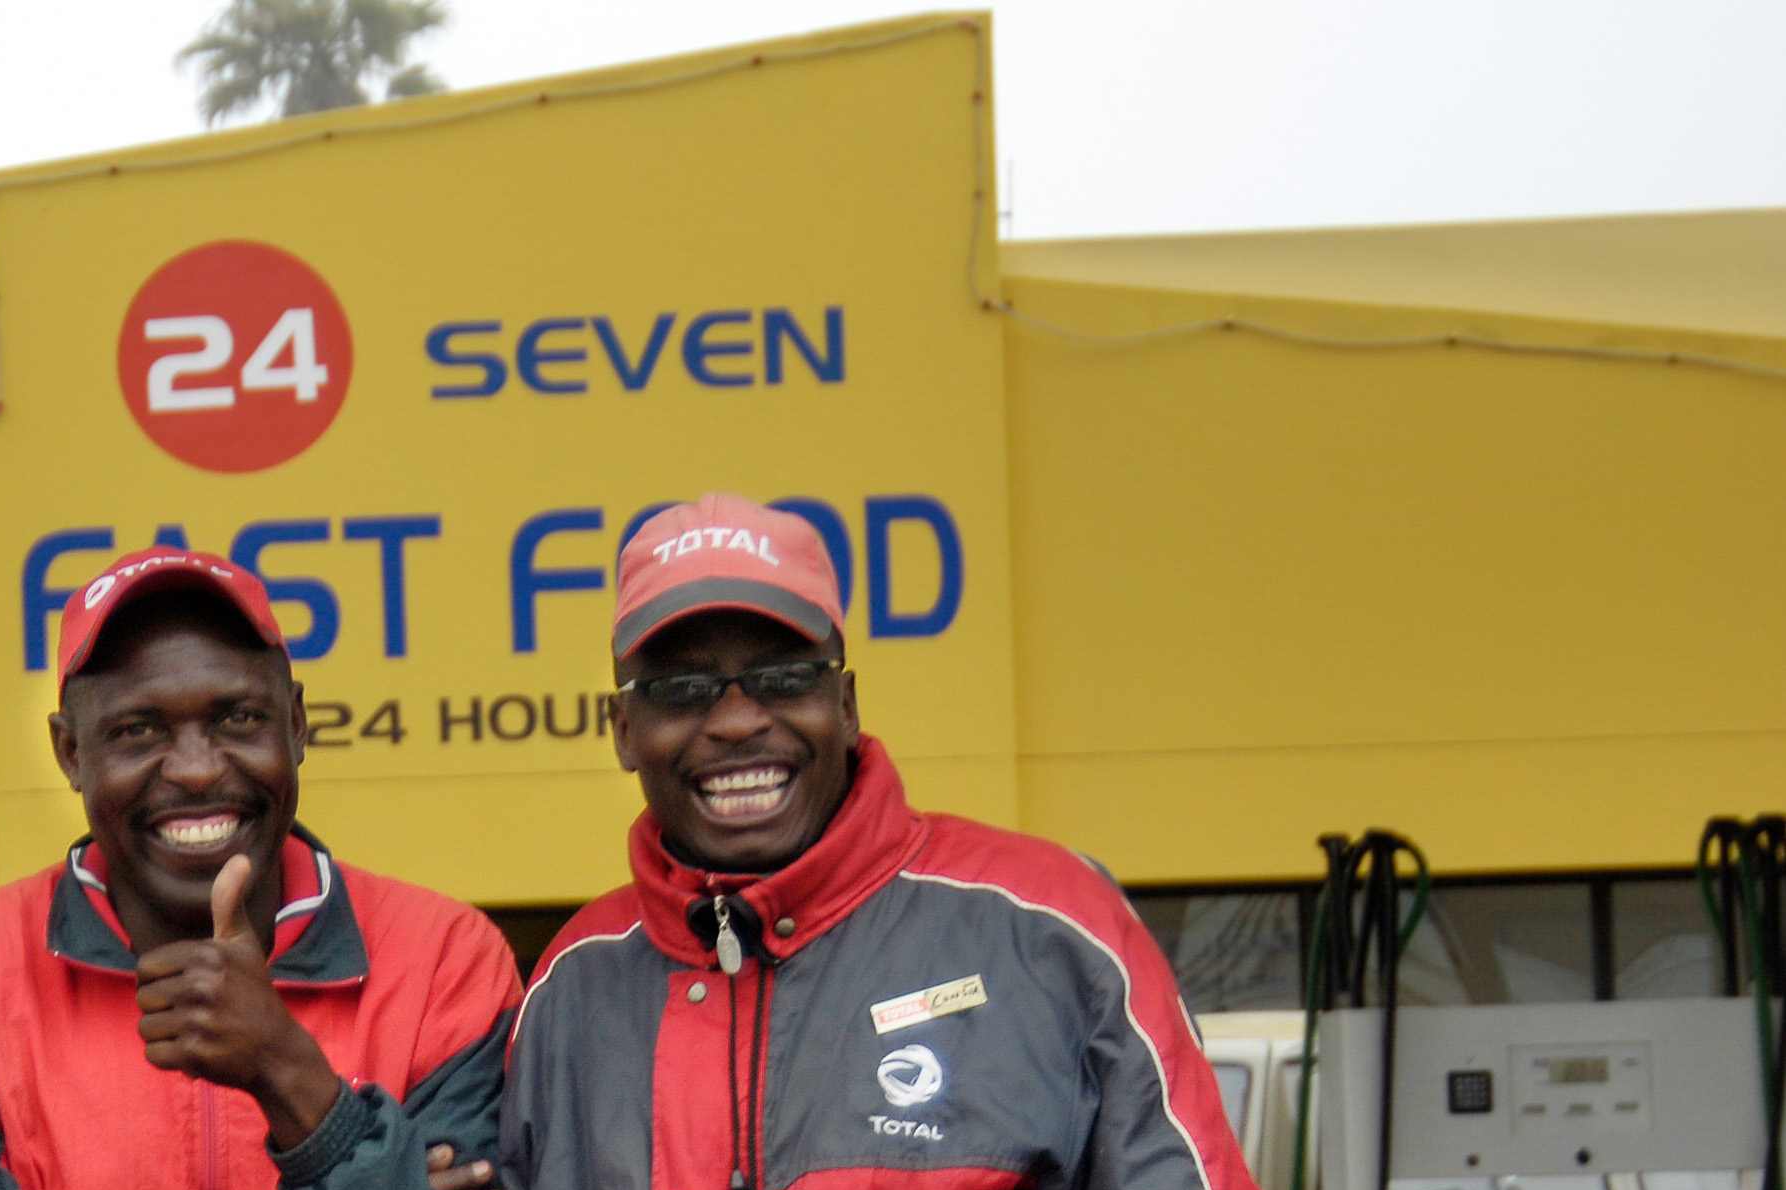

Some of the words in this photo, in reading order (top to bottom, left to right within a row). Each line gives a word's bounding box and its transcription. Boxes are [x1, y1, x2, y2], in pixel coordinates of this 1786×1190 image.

[144, 307, 329, 414] 24
[424, 305, 844, 400] SEVEN
[652, 526, 781, 568] TOTAL
[21, 512, 443, 673] FST
[509, 494, 965, 655] FD
[305, 698, 409, 747] 24
[868, 1115, 945, 1142] TOTAL
